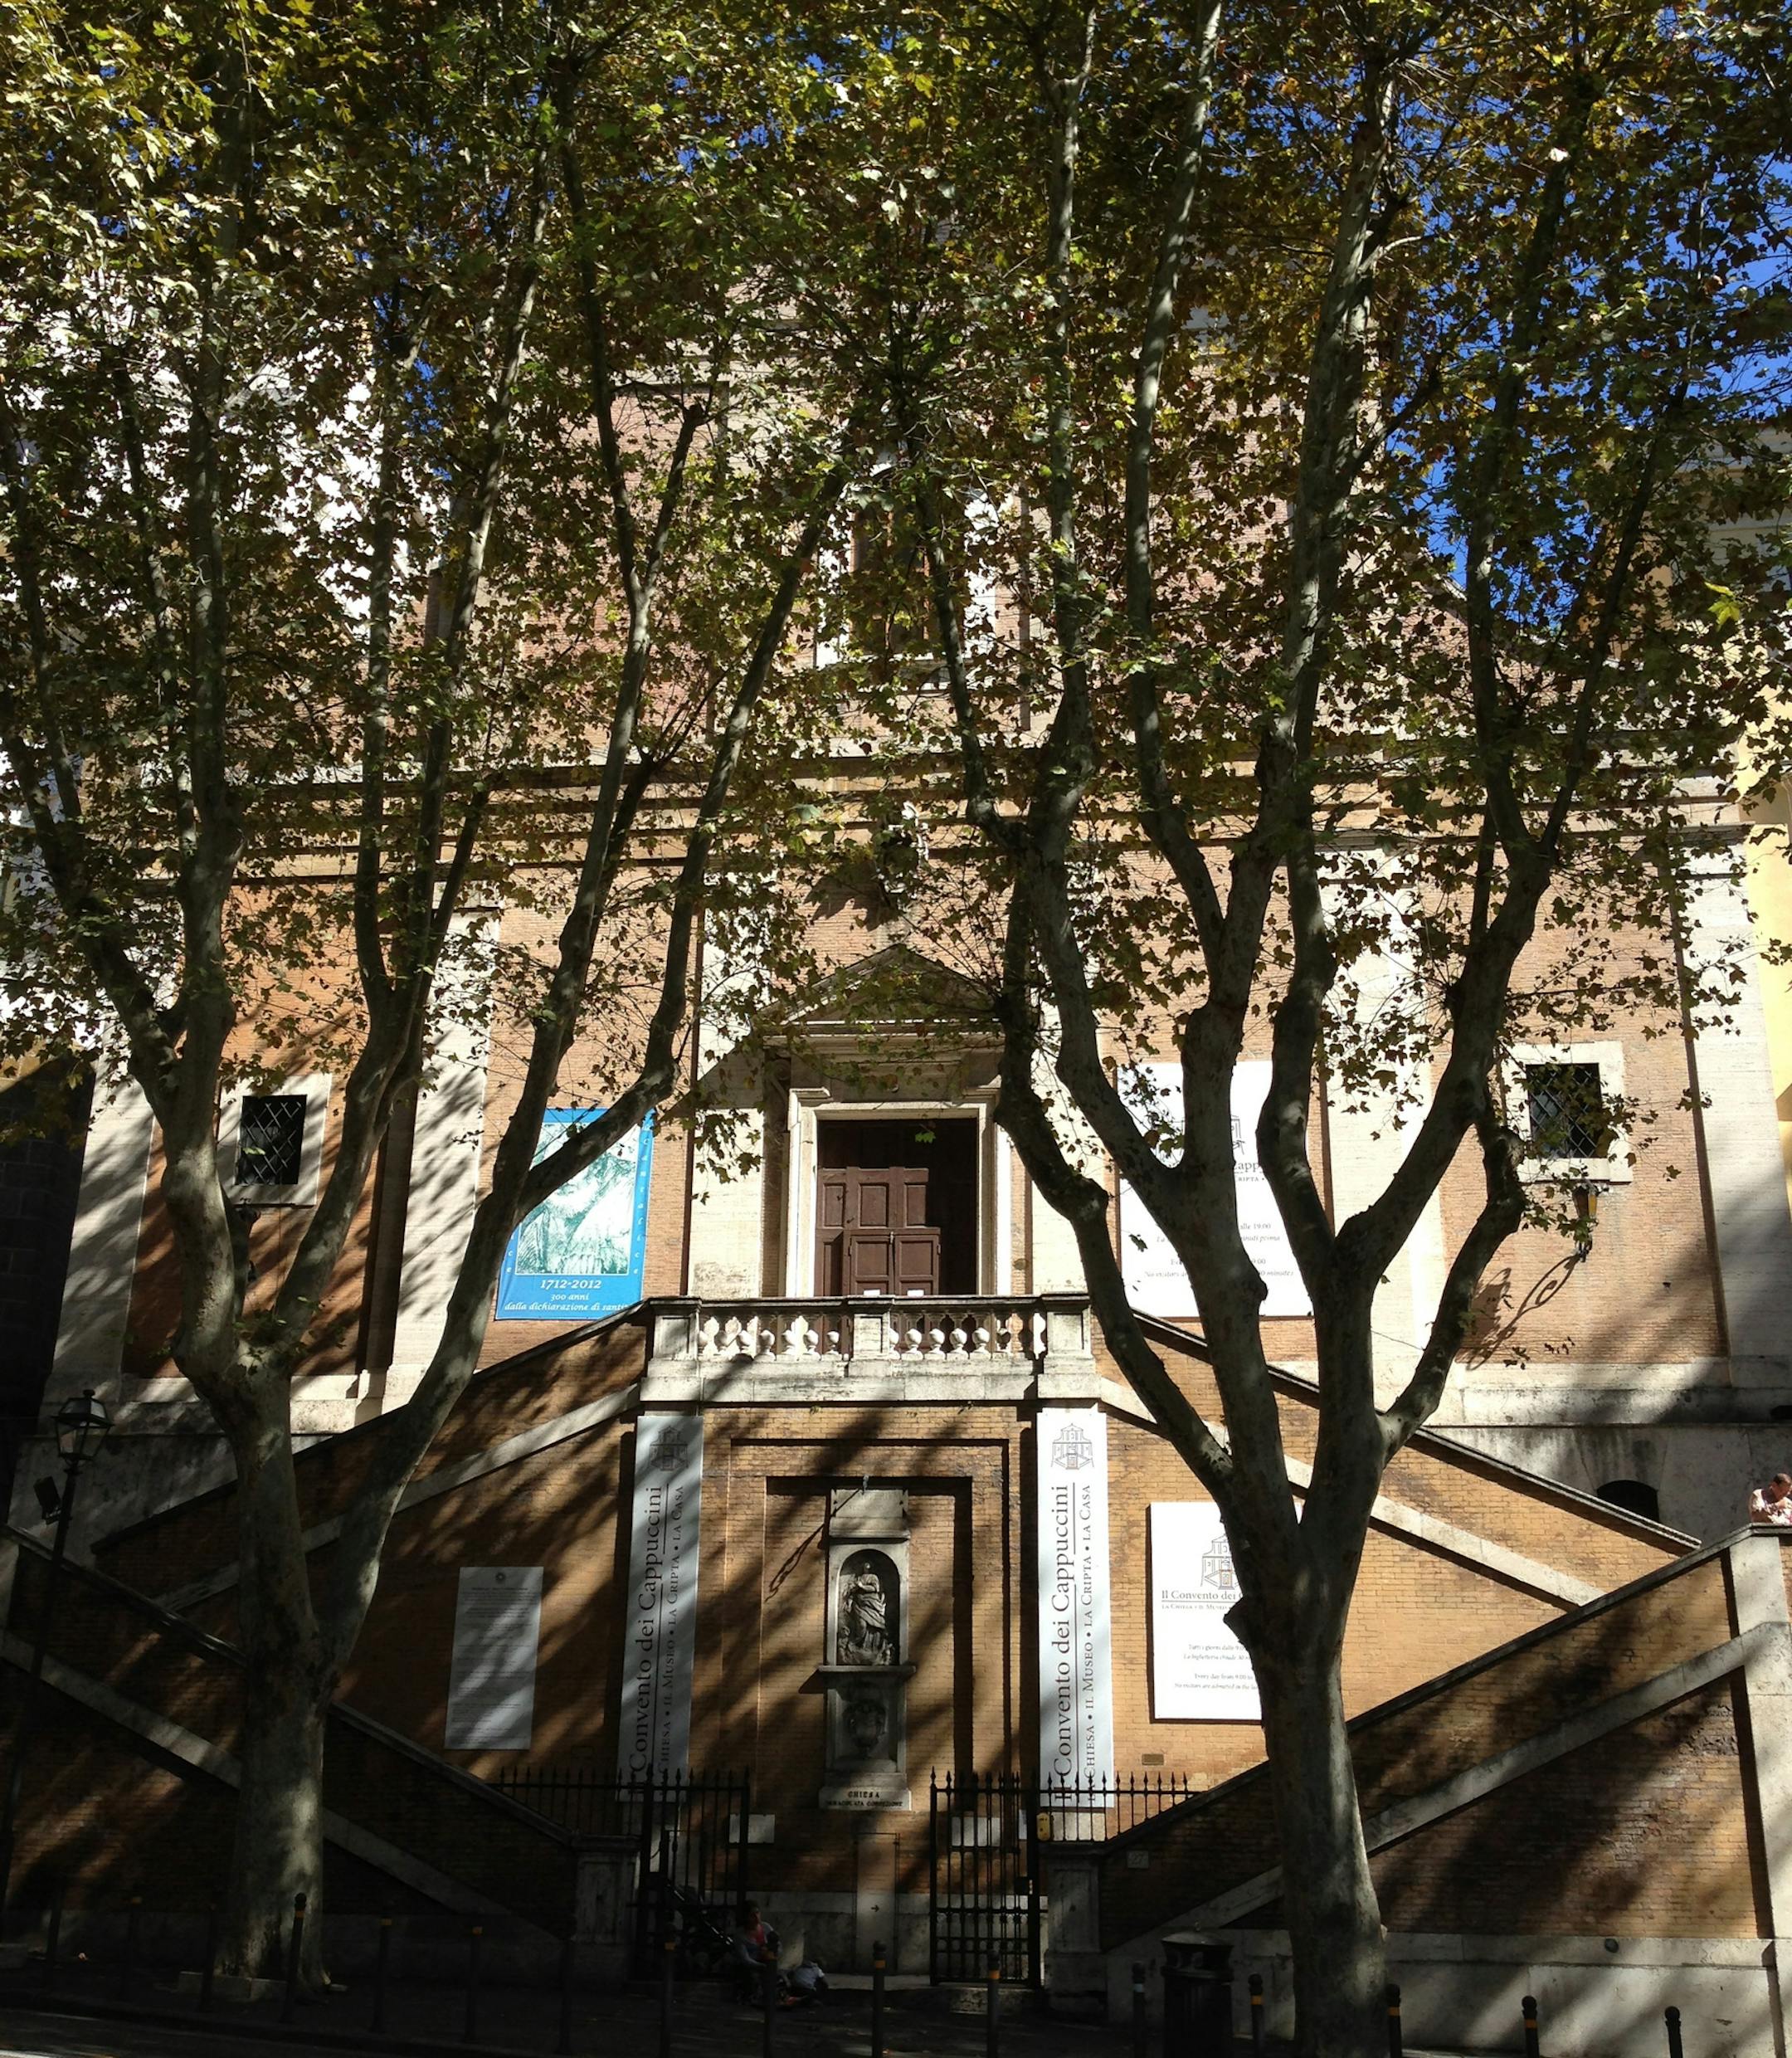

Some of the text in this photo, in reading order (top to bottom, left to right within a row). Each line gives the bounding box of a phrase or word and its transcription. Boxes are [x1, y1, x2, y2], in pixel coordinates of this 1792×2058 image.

[540, 1279, 601, 1290] 1712-2012
[504, 1302, 526, 1310] dalla
[528, 1301, 588, 1311] dichiarazione
[591, 1302, 601, 1311] di
[638, 1486, 663, 1612] Cappuccini
[1051, 1485, 1075, 1612] Cappuccini
[1161, 1589, 1169, 1599] Il
[1171, 1590, 1219, 1600] Convento
[1221, 1590, 1236, 1600] dei
[635, 1619, 655, 1651] dei
[1051, 1620, 1070, 1653] dei
[628, 1659, 652, 1773] Convento
[1053, 1661, 1073, 1777] Convento
